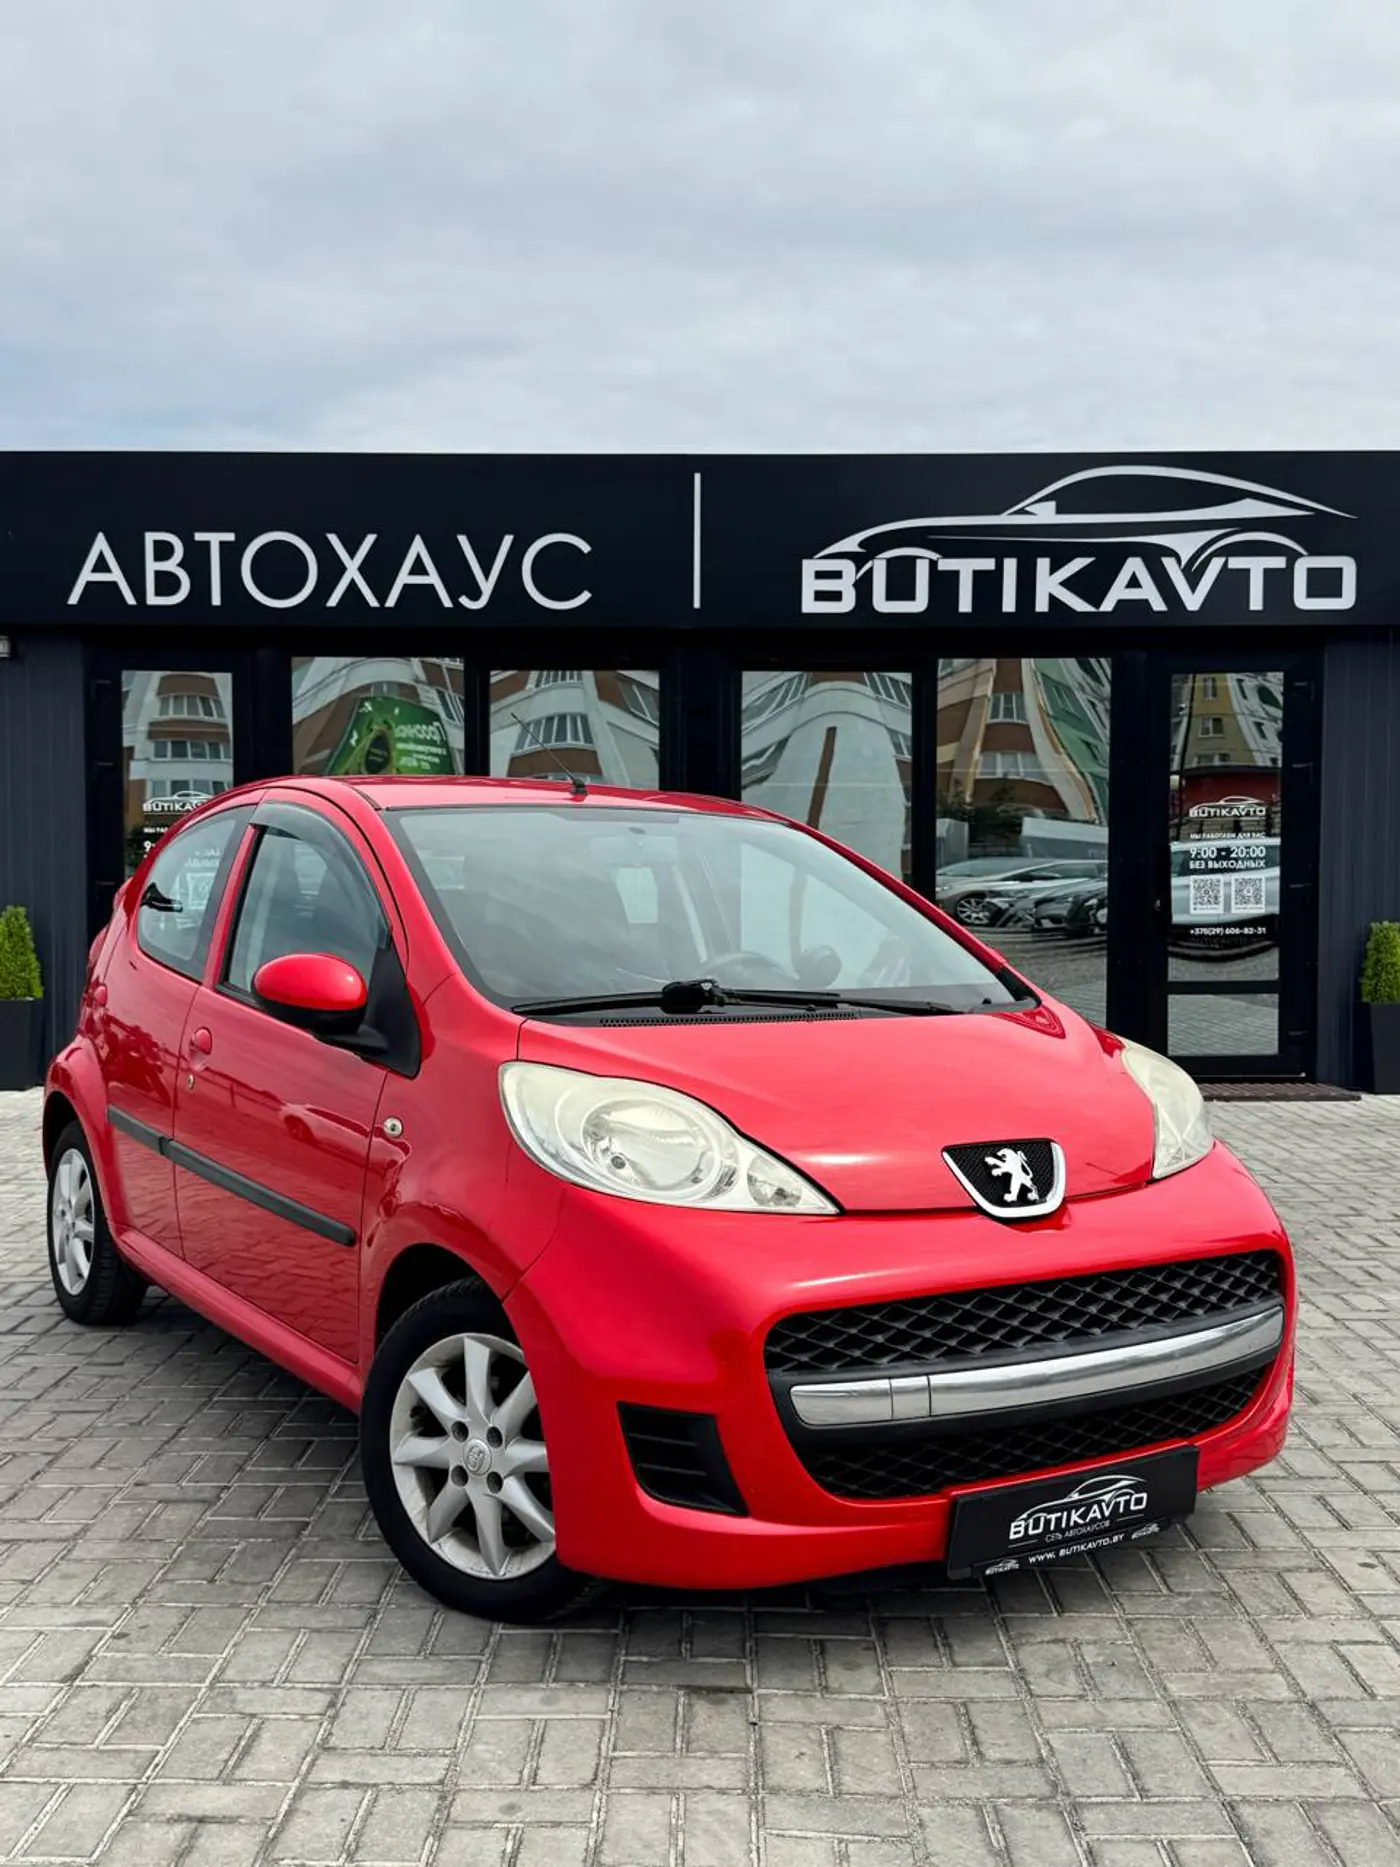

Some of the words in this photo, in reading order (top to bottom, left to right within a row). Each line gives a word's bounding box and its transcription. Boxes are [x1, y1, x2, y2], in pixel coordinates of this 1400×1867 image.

[67, 531, 593, 610] АВТОХАУС
[801, 554, 1357, 613] BUTIKAVTO
[143, 801, 197, 811] BUTIKA
[1189, 806, 1266, 818] BUTIKAVTO
[1190, 847, 1217, 859] 9:00
[1230, 846, 1266, 858] 20:00
[1189, 860, 1205, 869] БЕЗ
[1207, 859, 1266, 869] ВЫХОДНЫХ
[1009, 1492, 1148, 1540] BUTIKAVTO
